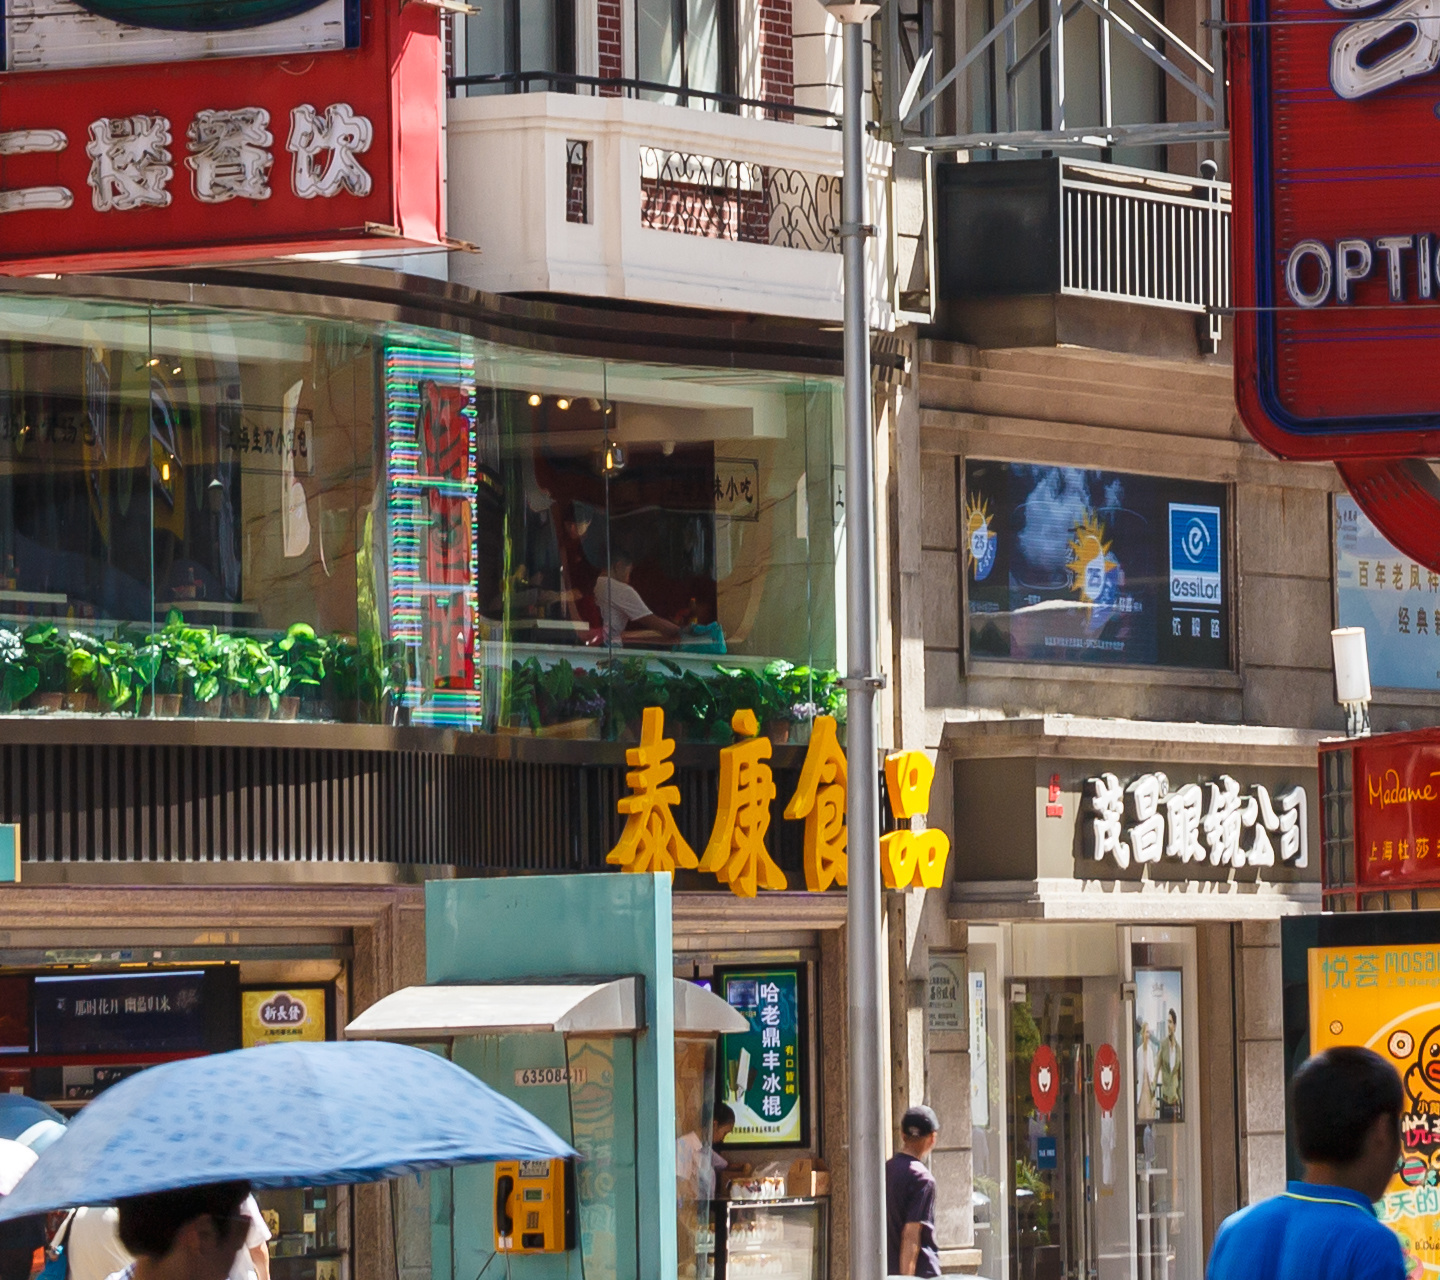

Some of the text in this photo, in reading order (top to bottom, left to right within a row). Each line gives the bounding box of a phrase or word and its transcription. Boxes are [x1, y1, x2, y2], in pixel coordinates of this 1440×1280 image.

[1172, 577, 1219, 599] essilor
[606, 706, 950, 898] 泰康食品
[1088, 772, 1308, 870] 茂昌眼镜公司
[1368, 769, 1437, 809] Madame
[1322, 953, 1379, 989] 悦荟
[760, 982, 782, 1116] 哈老鼎丰冰棍
